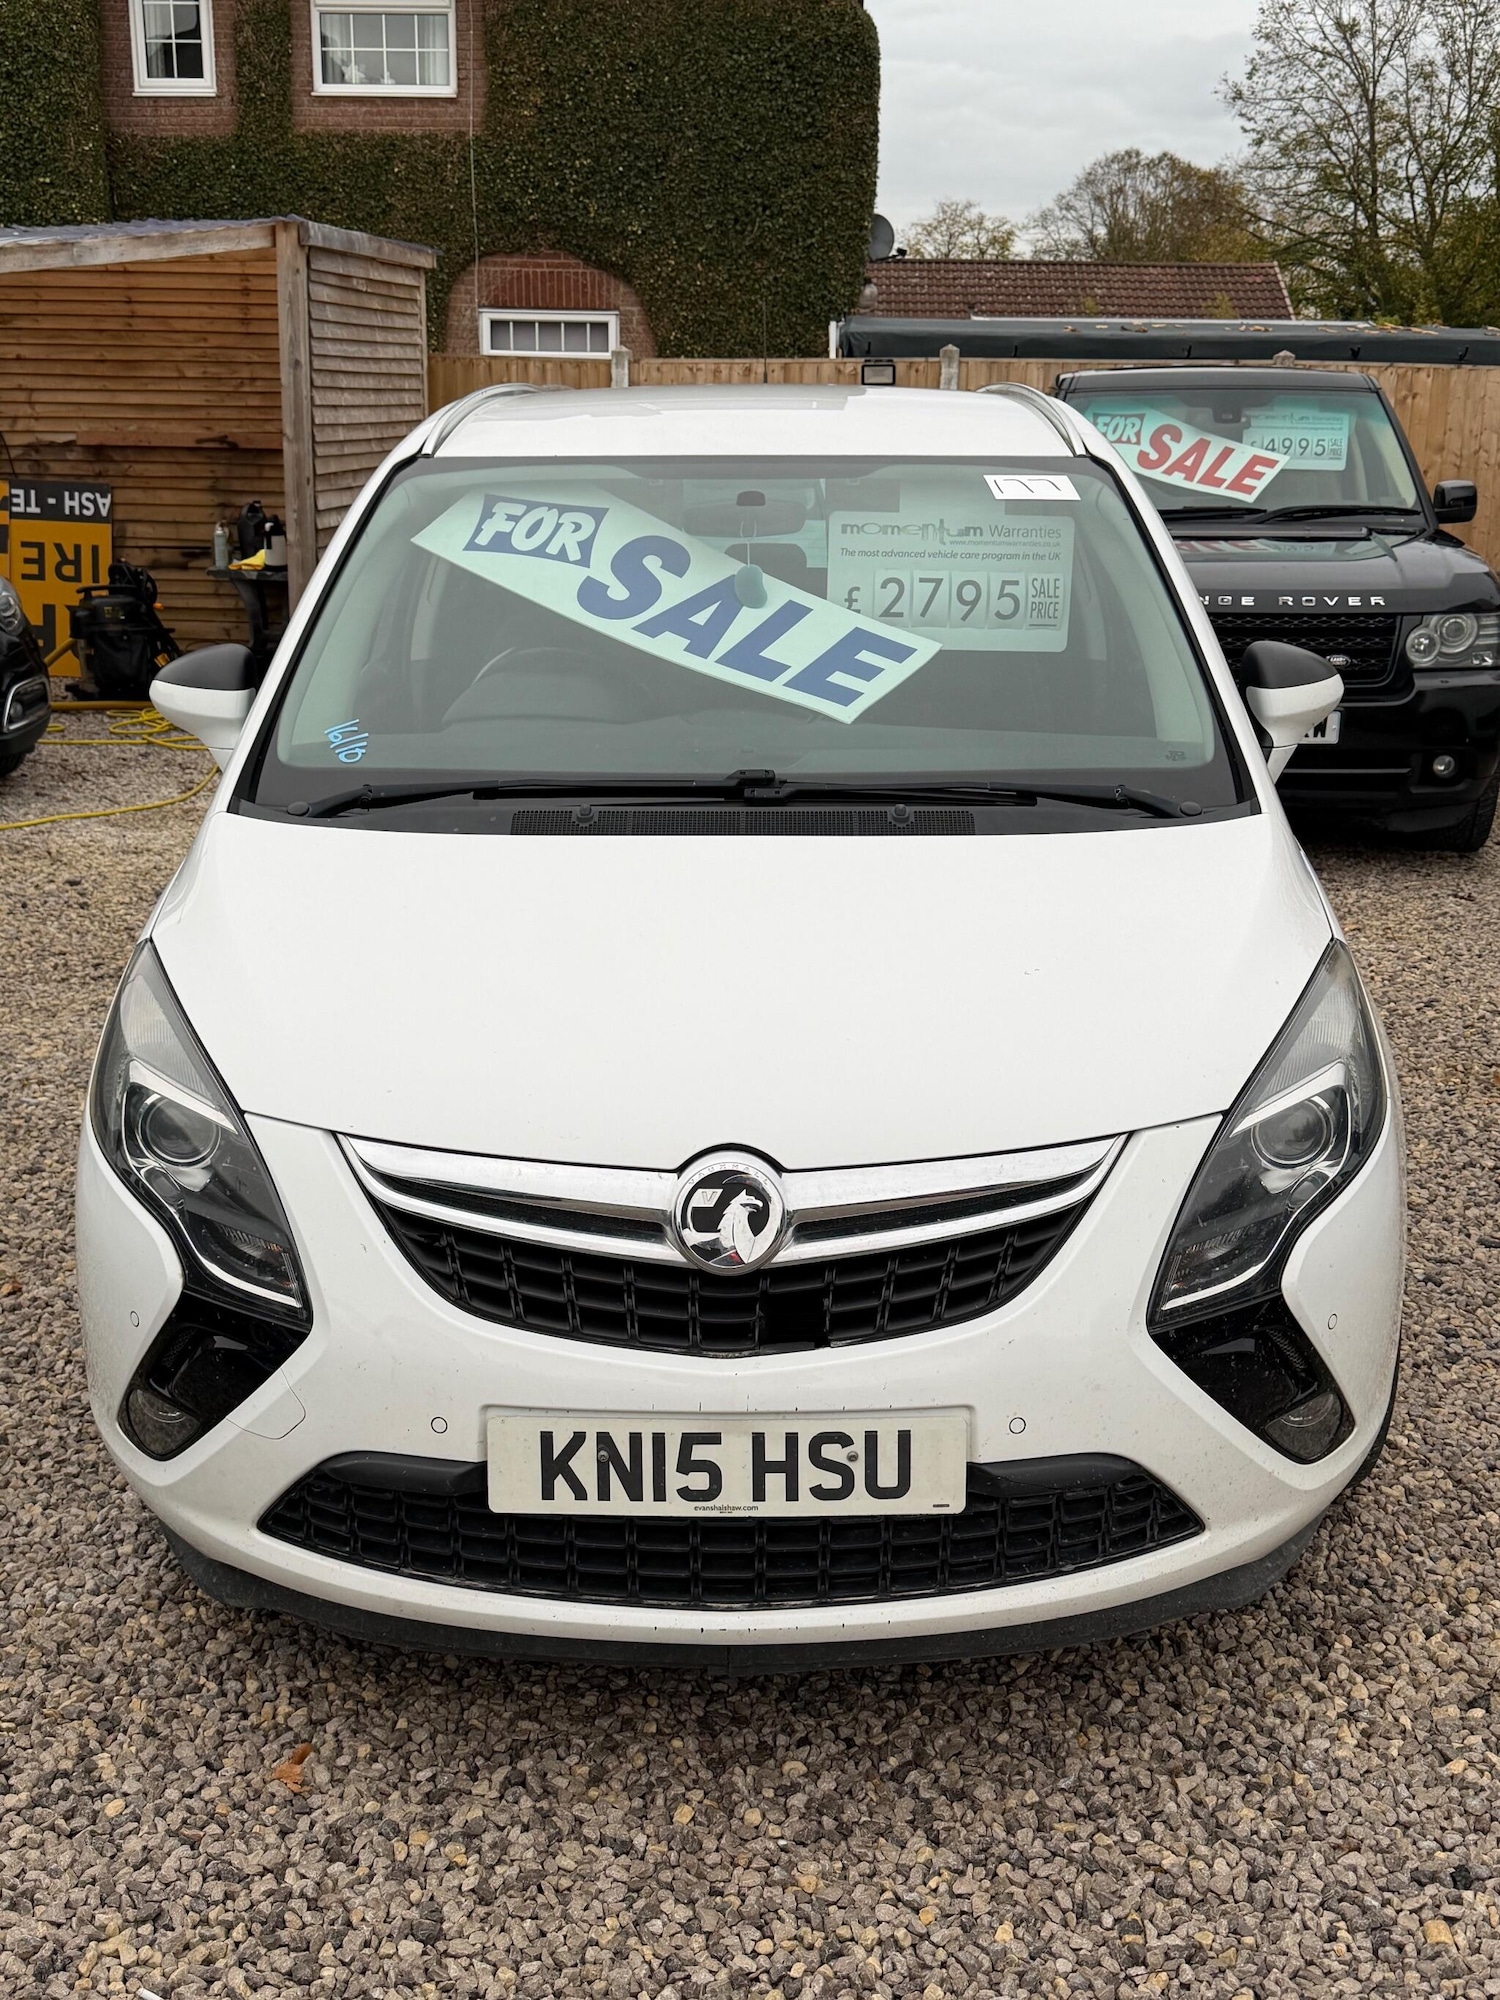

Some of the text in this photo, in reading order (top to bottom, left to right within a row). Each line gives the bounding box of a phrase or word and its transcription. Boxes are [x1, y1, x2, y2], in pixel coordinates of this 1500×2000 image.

[1094, 413, 1279, 495] FOR SALE
[64, 491, 112, 517] ASH
[989, 524, 1061, 539] Warranties
[20, 541, 100, 584] IRE
[840, 547, 1061, 561] The most advanced vehicle care program in the UK
[1031, 577, 1060, 598] SALE
[473, 501, 918, 707] FOR SALE
[1029, 601, 1059, 619] PRICE
[1278, 596, 1386, 606] ROVER
[539, 1430, 912, 1502] KN15 HSU
[693, 1504, 759, 1512] evanshalshaw.com
